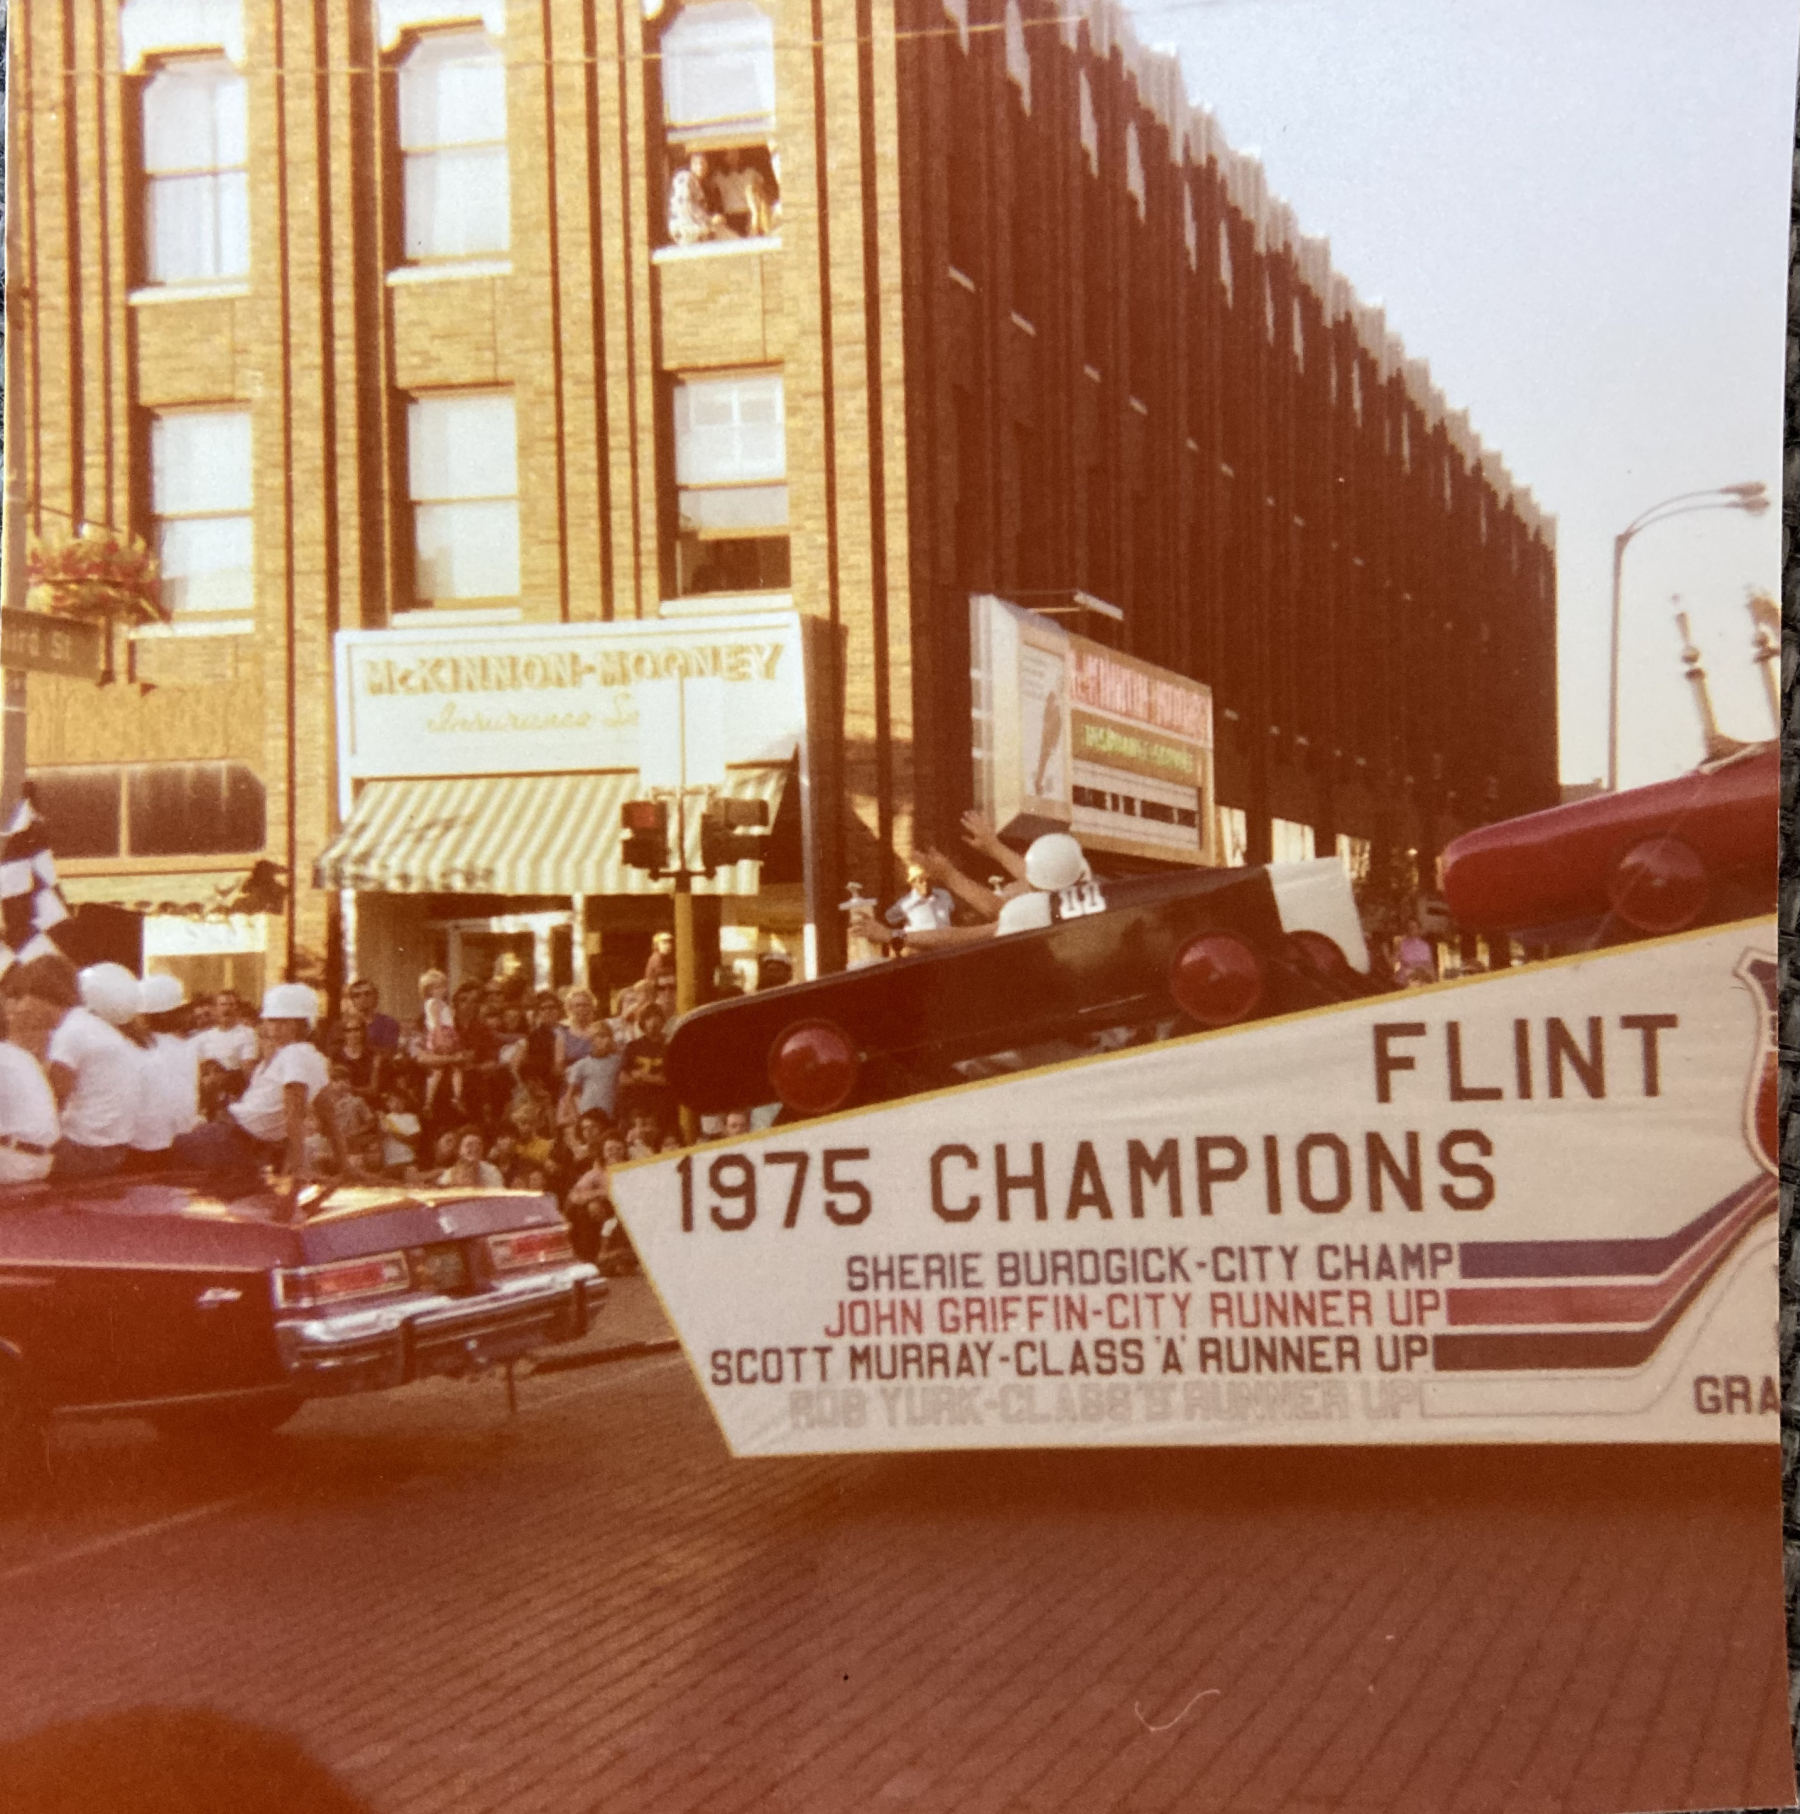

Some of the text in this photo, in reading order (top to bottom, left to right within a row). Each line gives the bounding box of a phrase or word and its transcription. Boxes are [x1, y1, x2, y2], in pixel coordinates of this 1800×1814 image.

[1373, 1014, 1678, 1103] FLINT
[676, 1129, 1495, 1232] 1975 CHAMPIONS
[847, 1242, 1454, 1292] SHERIE BURDGICK-CITY CHAMP
[825, 1288, 1440, 1338] JOHN GRIFFIN-CITY RUNNER UP
[711, 1346, 833, 1386] SCOTT
[848, 1337, 1145, 1381] MURRAY-CLASS
[1199, 1334, 1361, 1374] RUNNER
[1376, 1333, 1429, 1373] UP
[1693, 1375, 1779, 1415] GRA
